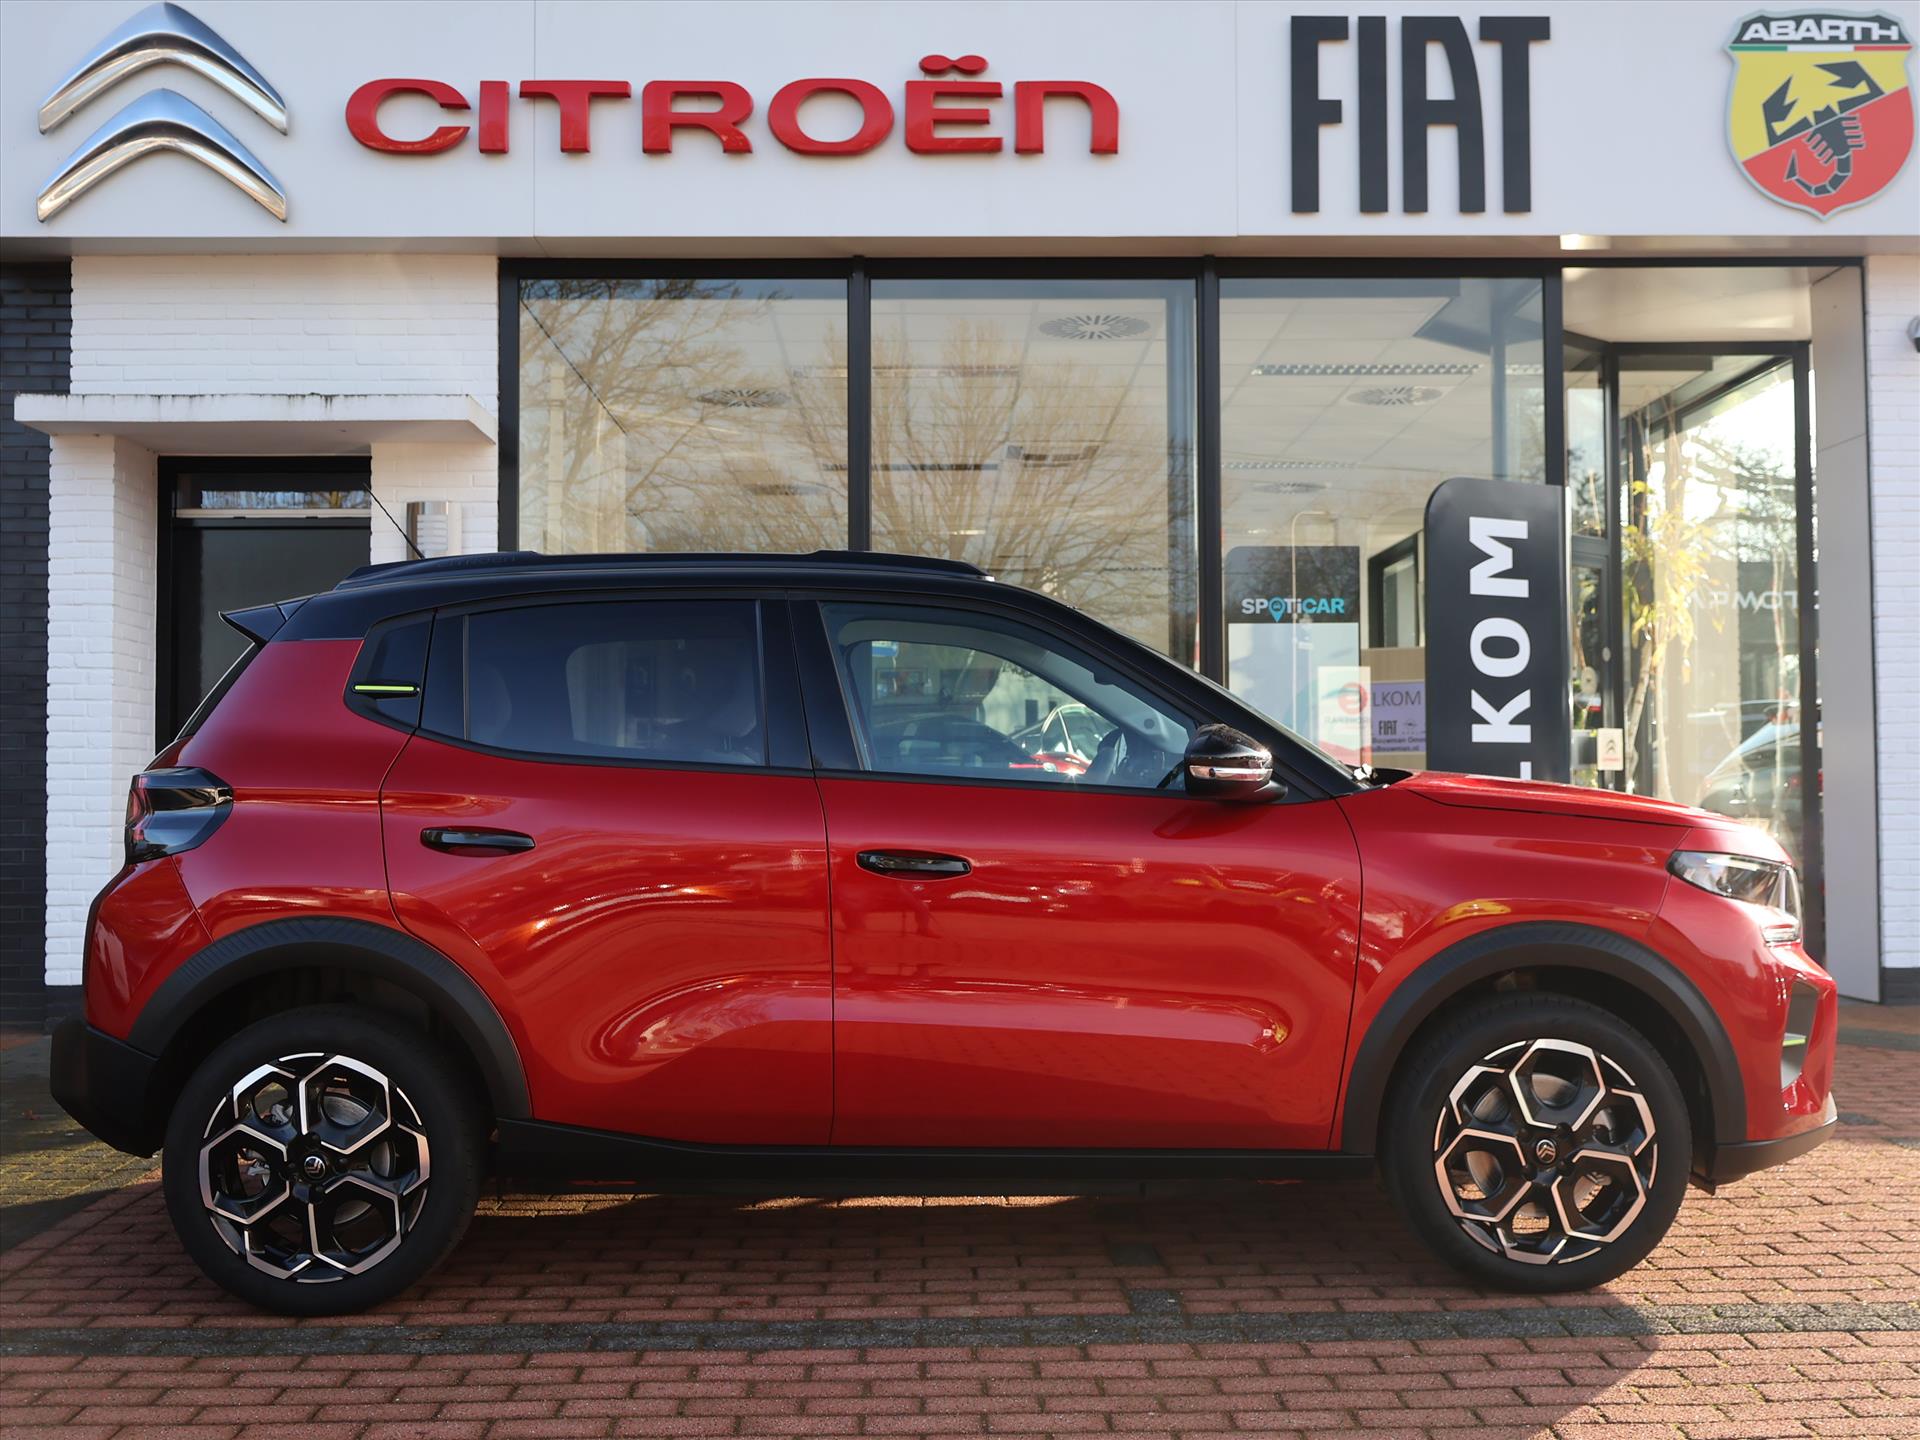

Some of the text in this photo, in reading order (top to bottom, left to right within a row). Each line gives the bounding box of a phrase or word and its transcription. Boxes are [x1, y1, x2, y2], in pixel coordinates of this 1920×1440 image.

[1741, 18, 1899, 41] ABARTH
[345, 53, 1120, 155] CITROËN
[1290, 16, 1550, 214] FIAT
[1469, 516, 1532, 780] KOM
[1373, 690, 1421, 707] LKOM
[1378, 720, 1398, 735] FIAT
